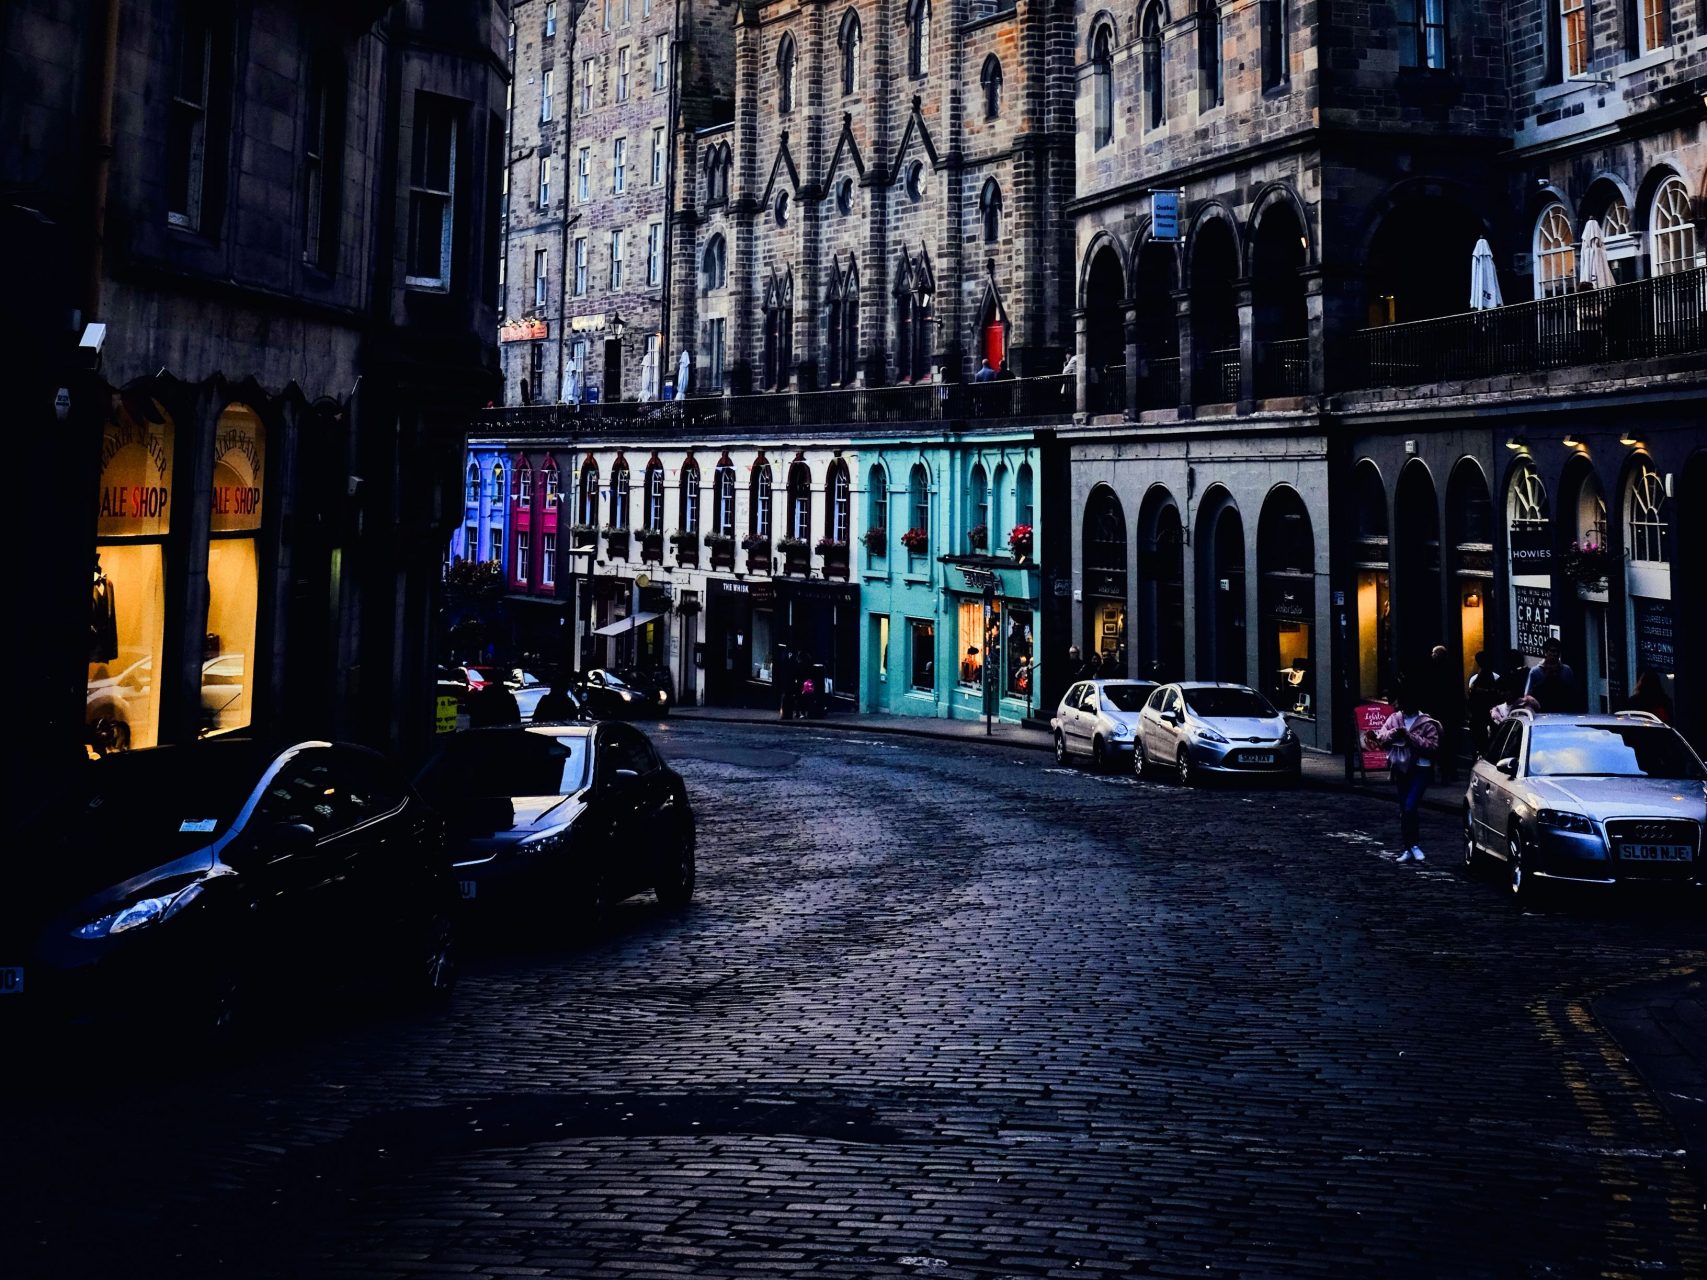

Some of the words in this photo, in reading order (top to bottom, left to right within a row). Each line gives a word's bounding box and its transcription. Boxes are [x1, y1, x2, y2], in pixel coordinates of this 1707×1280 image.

[215, 429, 237, 462] ALKER
[100, 486, 127, 518] ALE
[131, 486, 168, 518] SHOP
[211, 487, 230, 515] ALE
[233, 487, 260, 515] SHOP
[1513, 549, 1552, 559] HOWIES
[1517, 595, 1535, 605] FAMILY
[1517, 606, 1550, 623] CRAF
[1518, 621, 1529, 631] EAT
[1661, 846, 1687, 860] NJE
